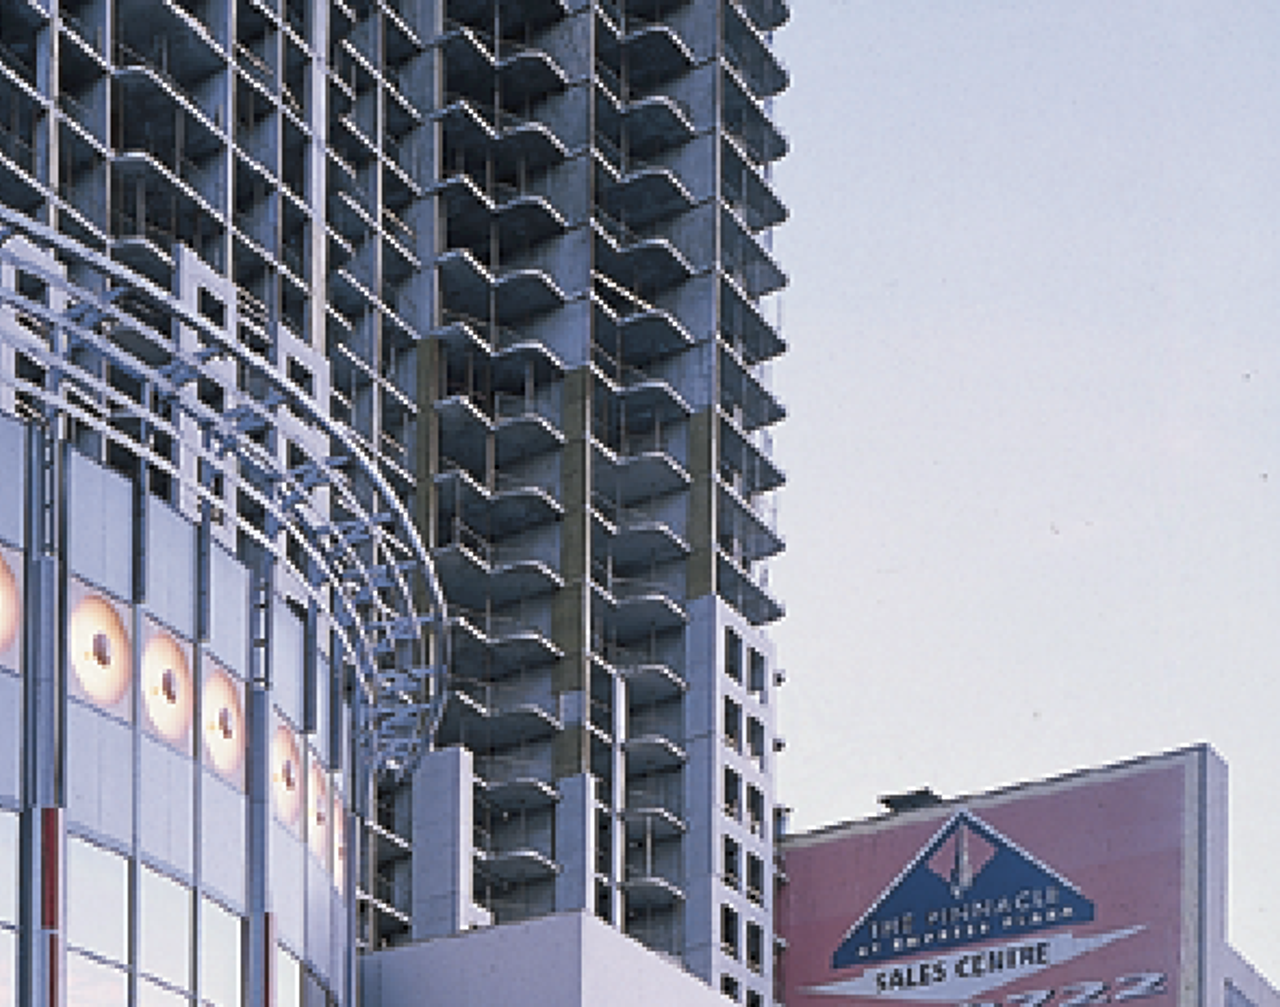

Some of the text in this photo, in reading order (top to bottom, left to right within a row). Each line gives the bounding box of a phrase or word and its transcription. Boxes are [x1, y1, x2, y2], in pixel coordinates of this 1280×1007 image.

[928, 885, 1060, 927] PINNACLE
[875, 941, 1052, 994] SALES CENTRE
